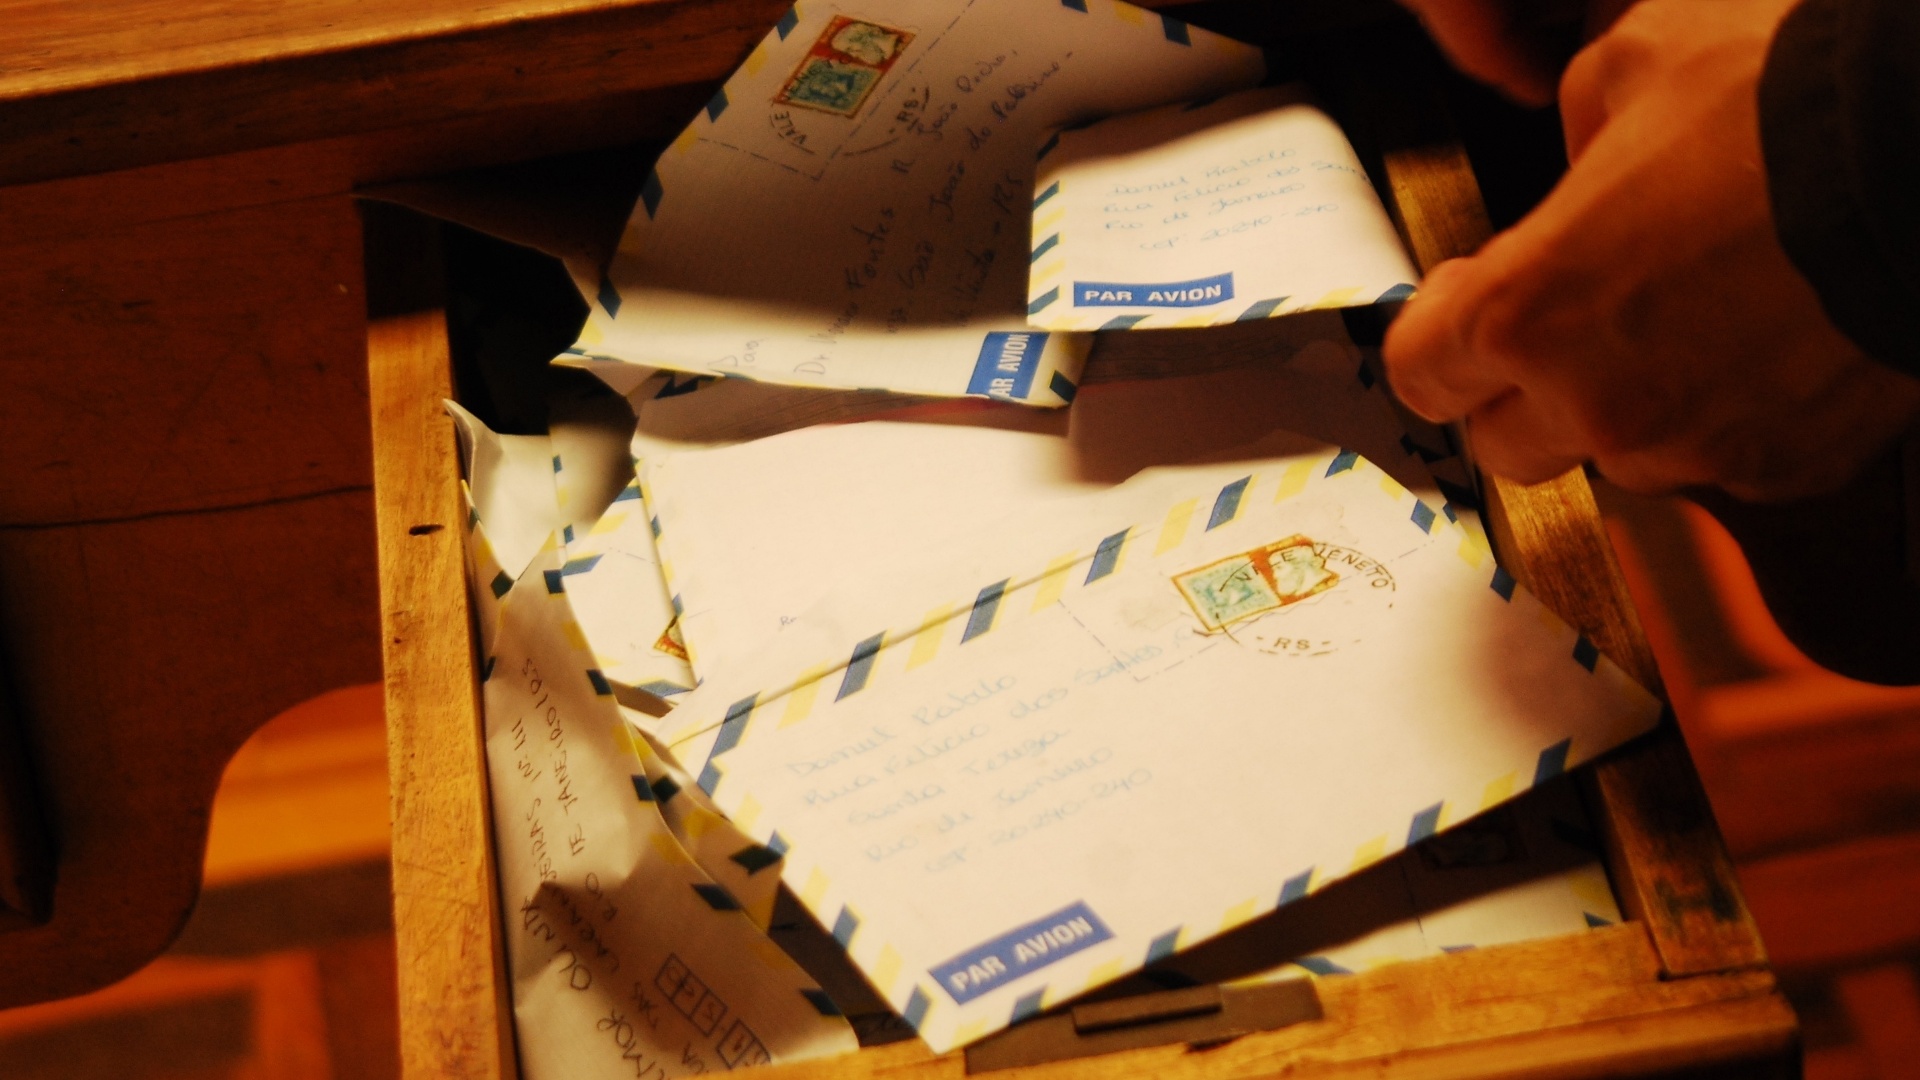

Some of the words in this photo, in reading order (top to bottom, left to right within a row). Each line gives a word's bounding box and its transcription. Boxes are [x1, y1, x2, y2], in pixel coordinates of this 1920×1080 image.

[773, 110, 808, 145] VALE
[966, 125, 993, 151] do
[1102, 201, 1154, 216] Rua
[1162, 210, 1190, 226] de
[1083, 290, 1133, 303] PAR
[1148, 283, 1223, 303] AVION
[998, 333, 1031, 372] AVION
[988, 377, 1016, 397] AR
[1273, 636, 1311, 651] RS
[801, 774, 880, 810] Rua
[1009, 686, 1071, 721] dos
[950, 954, 1007, 993] PAR
[1013, 915, 1094, 965] AVION
